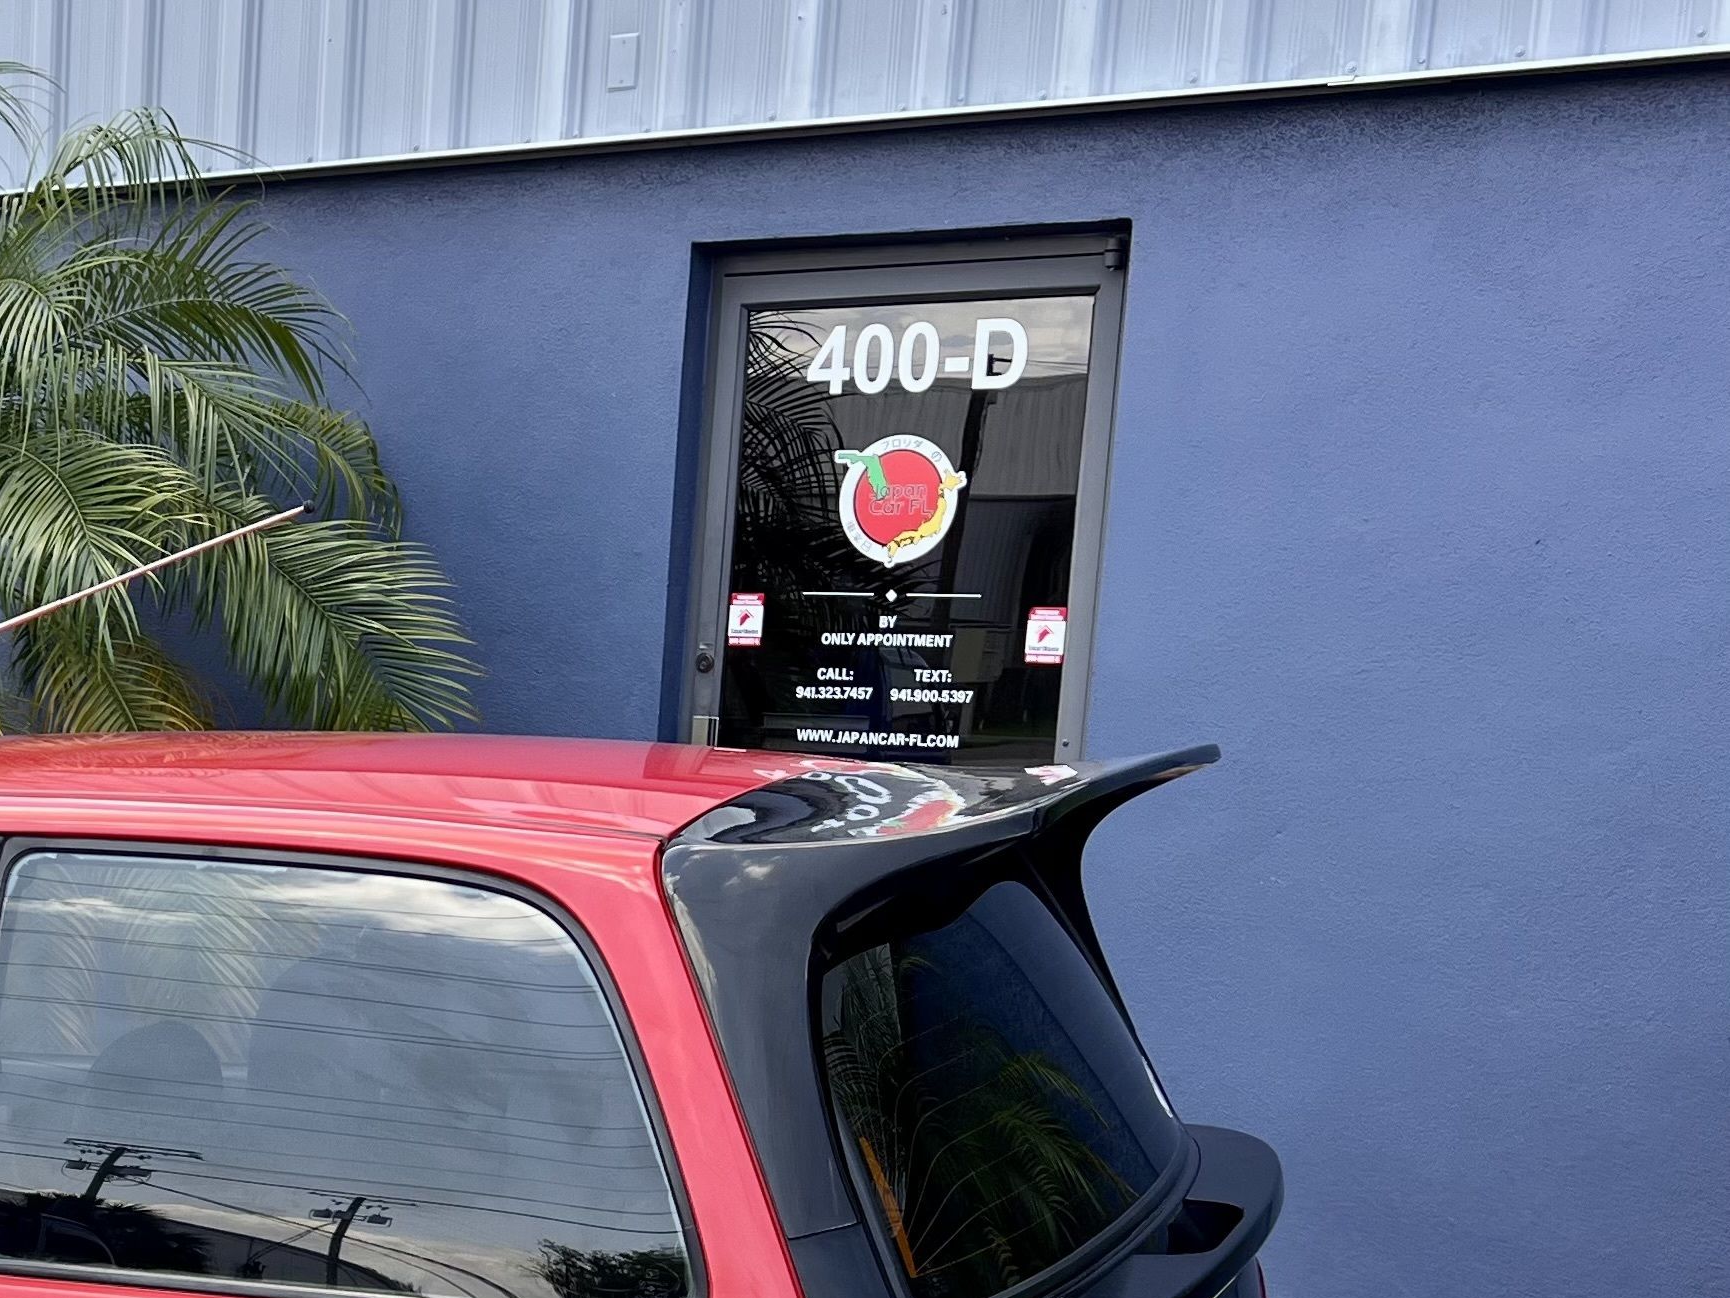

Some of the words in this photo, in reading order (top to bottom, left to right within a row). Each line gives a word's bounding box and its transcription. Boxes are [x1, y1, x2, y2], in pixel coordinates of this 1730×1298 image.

[806, 318, 1028, 395] 400-D
[871, 484, 928, 499] Japan
[870, 500, 903, 515] Car
[909, 499, 934, 515] FL
[878, 615, 897, 629] BY
[820, 632, 856, 646] ONLY
[857, 632, 954, 648] APPOINTMENT
[816, 667, 854, 681] CALL:
[913, 668, 953, 683] TEXT:
[795, 686, 874, 700] 941.323.7457
[889, 687, 974, 704] 941.900.5397
[796, 728, 960, 748] WWW.JAPANCAR-FL.COM
